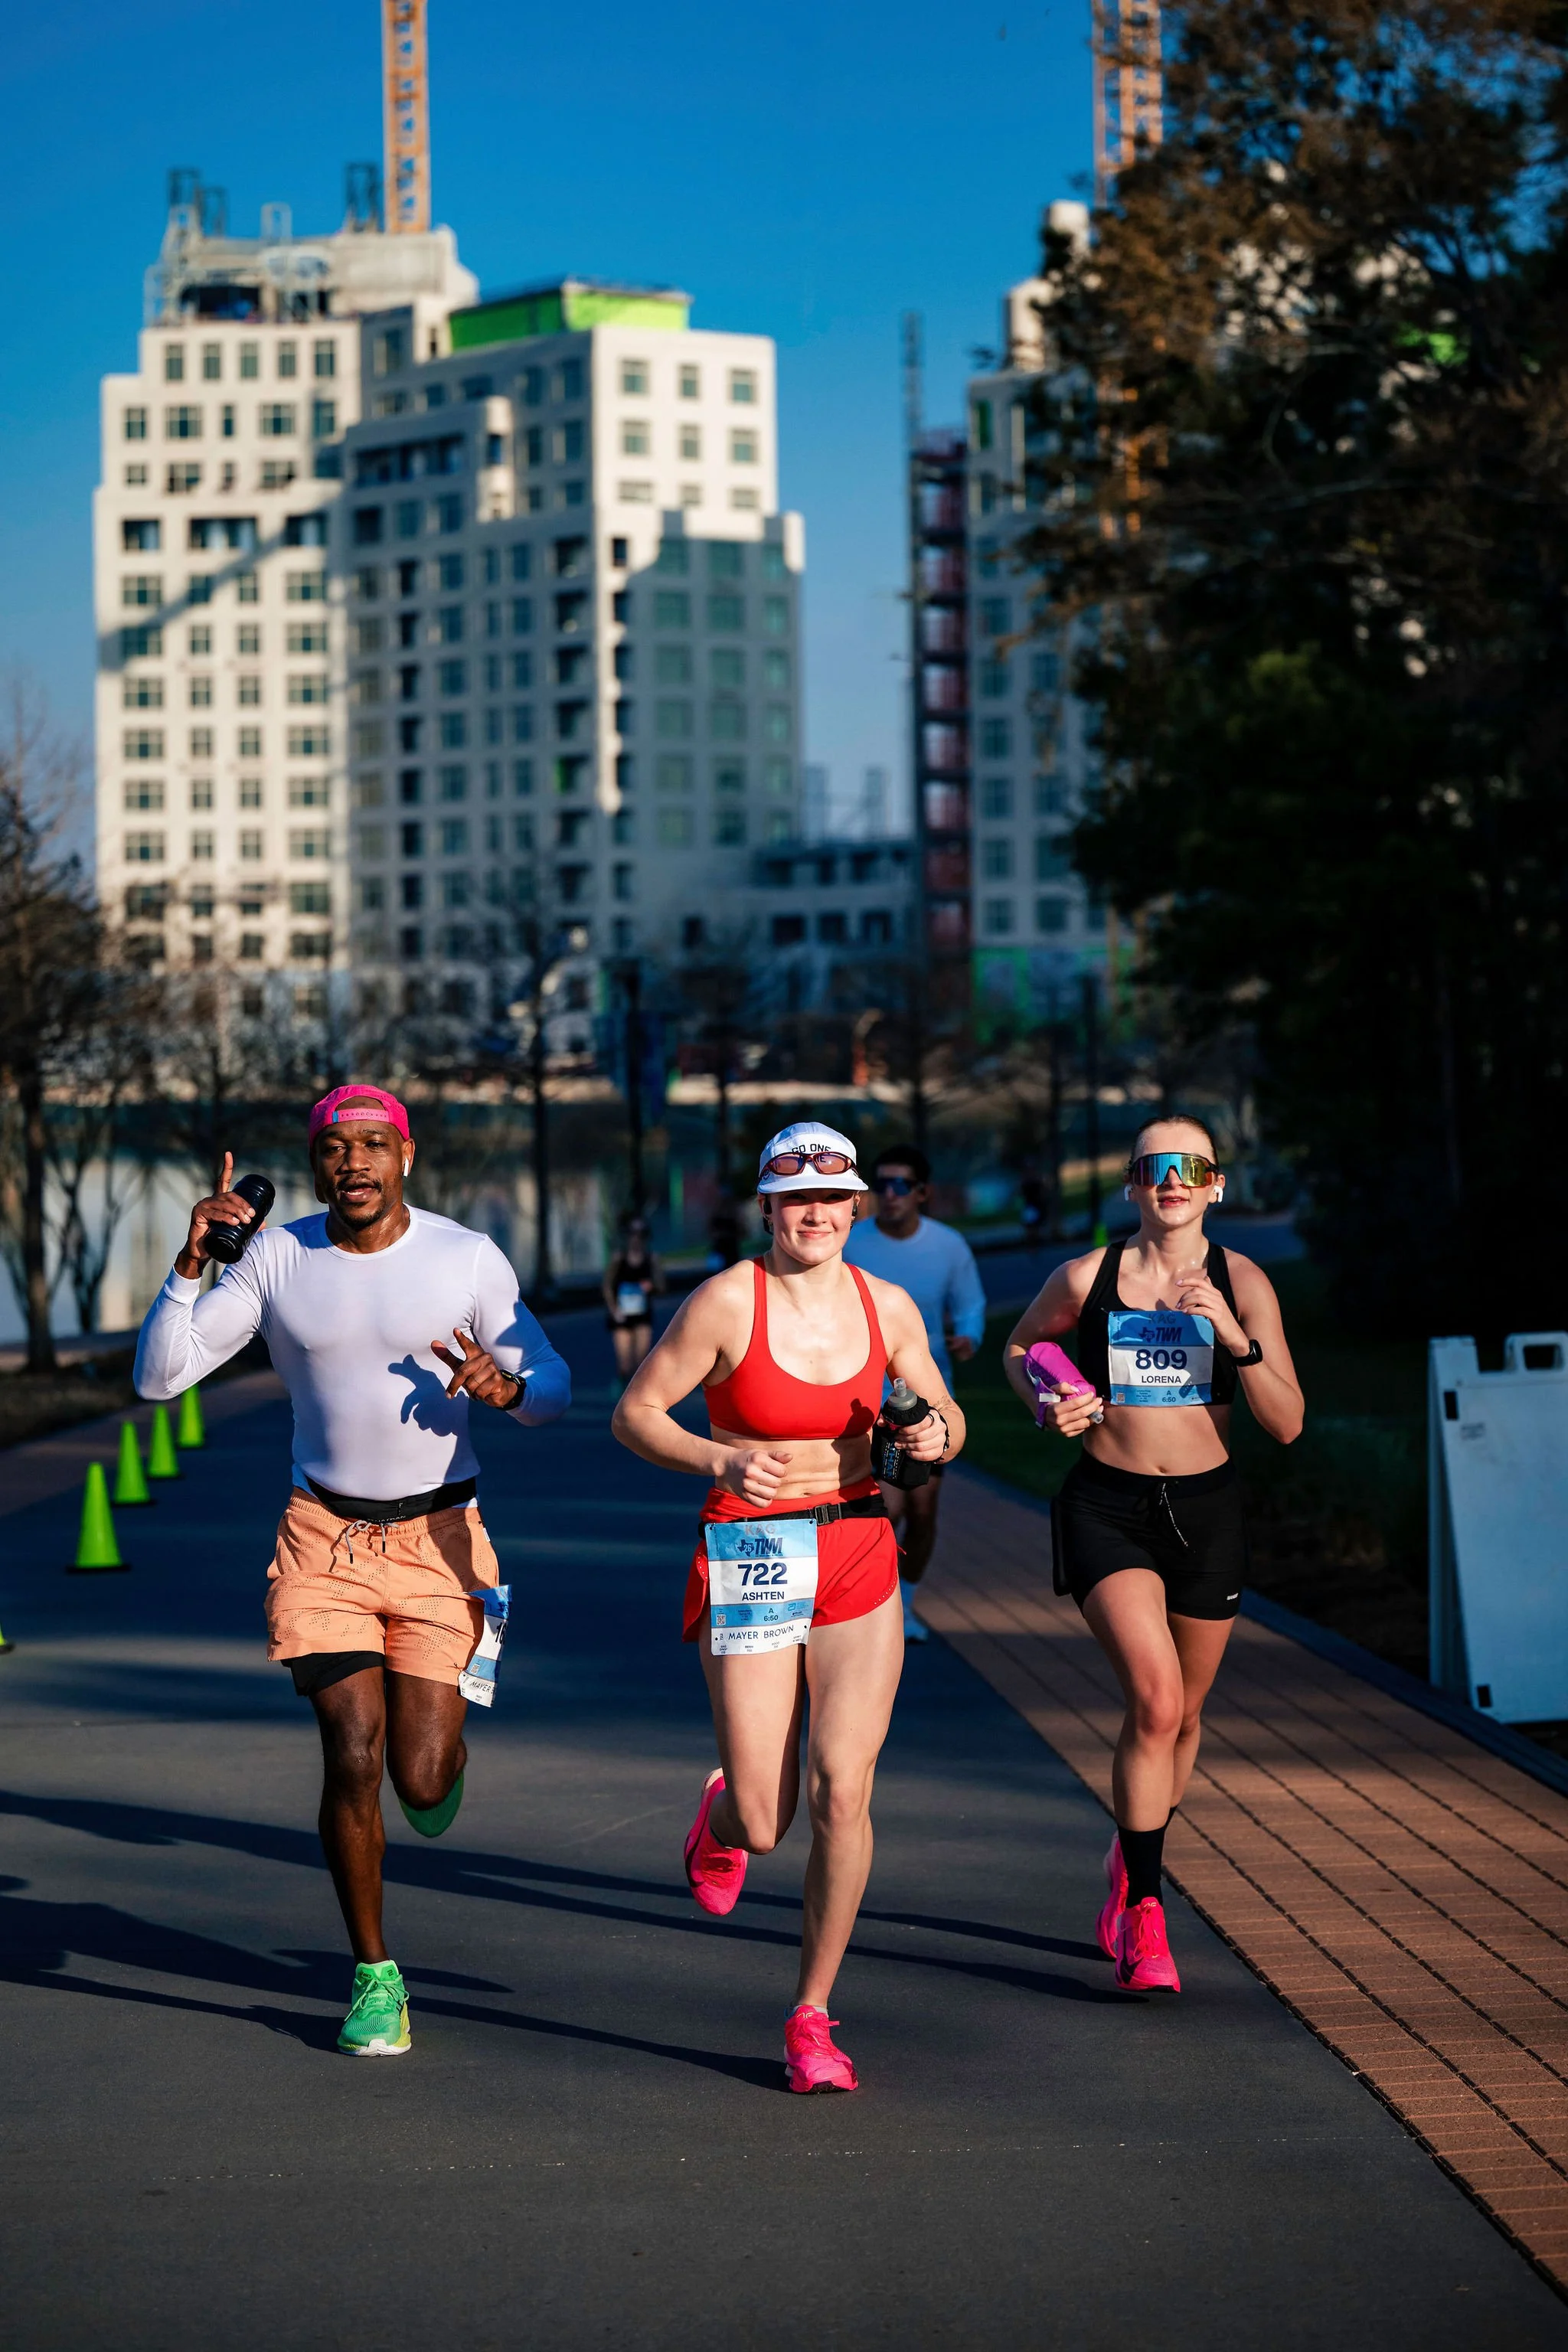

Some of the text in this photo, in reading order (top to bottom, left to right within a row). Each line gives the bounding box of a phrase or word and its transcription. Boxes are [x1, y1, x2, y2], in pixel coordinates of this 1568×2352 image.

[792, 1145, 805, 1153] GO
[1135, 1349, 1187, 1370] 809
[745, 1524, 775, 1536] KAG
[754, 1537, 783, 1554] TWM
[737, 1563, 788, 1586] 722
[742, 1591, 784, 1601] ASHTEN
[728, 1625, 794, 1640] MAYER BROWN
[470, 1681, 492, 1693] MAYER
